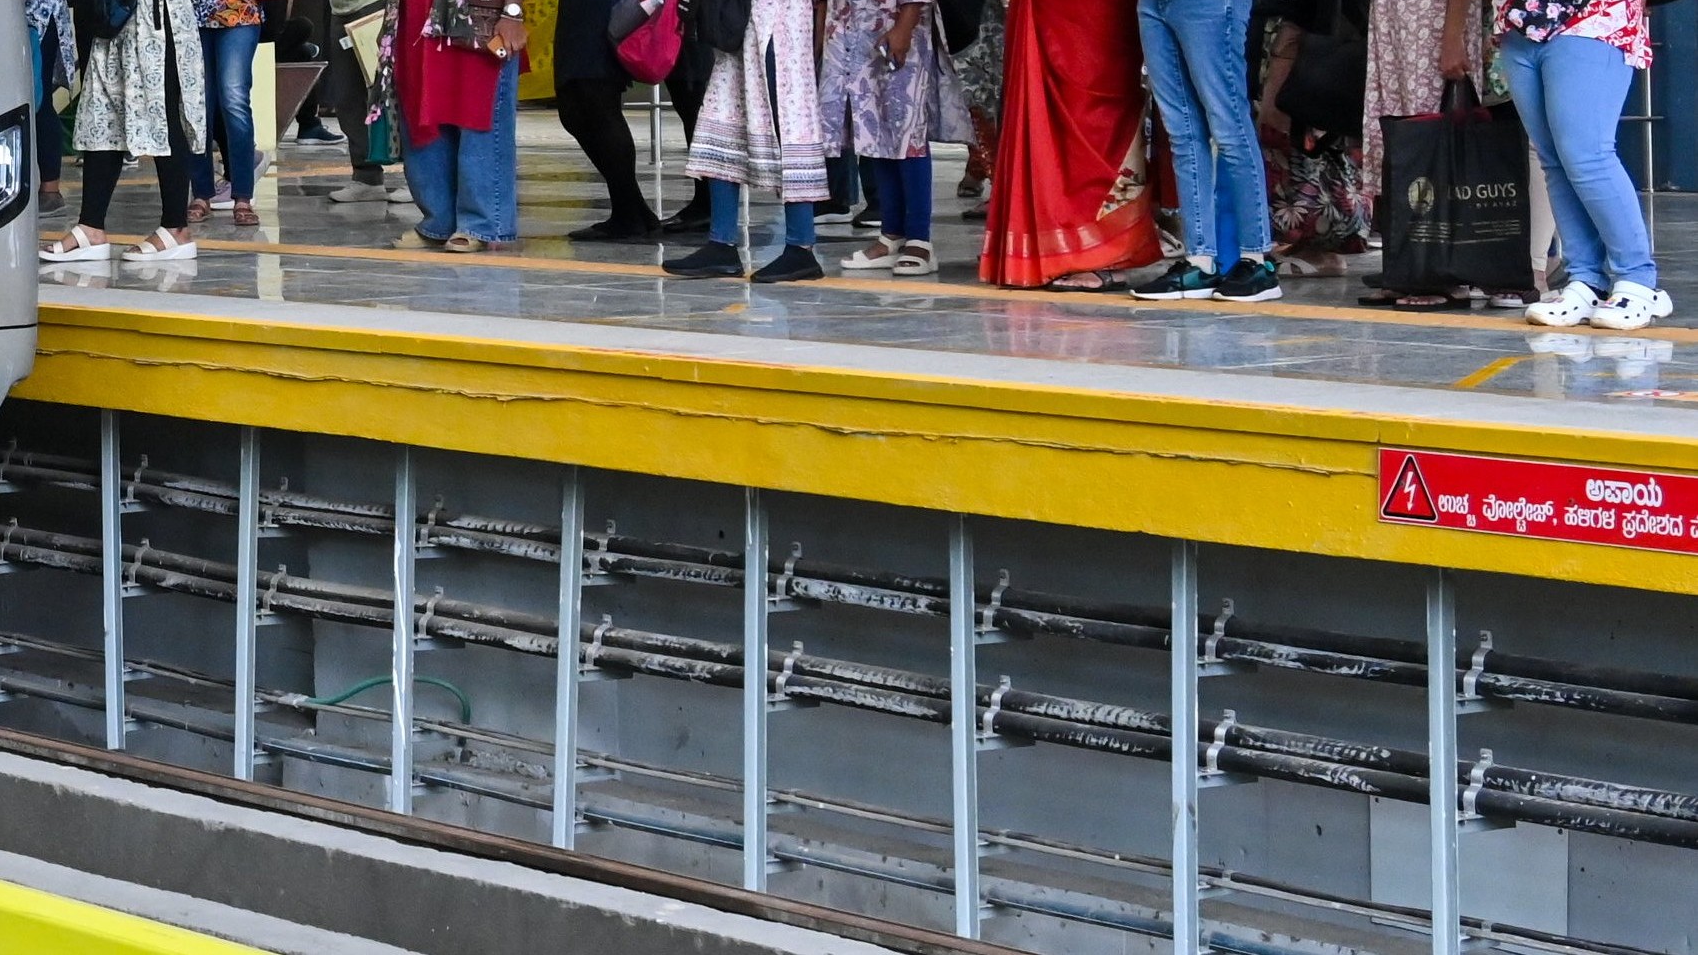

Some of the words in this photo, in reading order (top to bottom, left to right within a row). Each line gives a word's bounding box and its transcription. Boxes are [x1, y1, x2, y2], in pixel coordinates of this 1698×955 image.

[1475, 182, 1517, 200] GUYS
[1564, 504, 1616, 530] ಹಳಿಗಳ
[1622, 509, 1684, 539] ಪ್ರದೇಶದ
